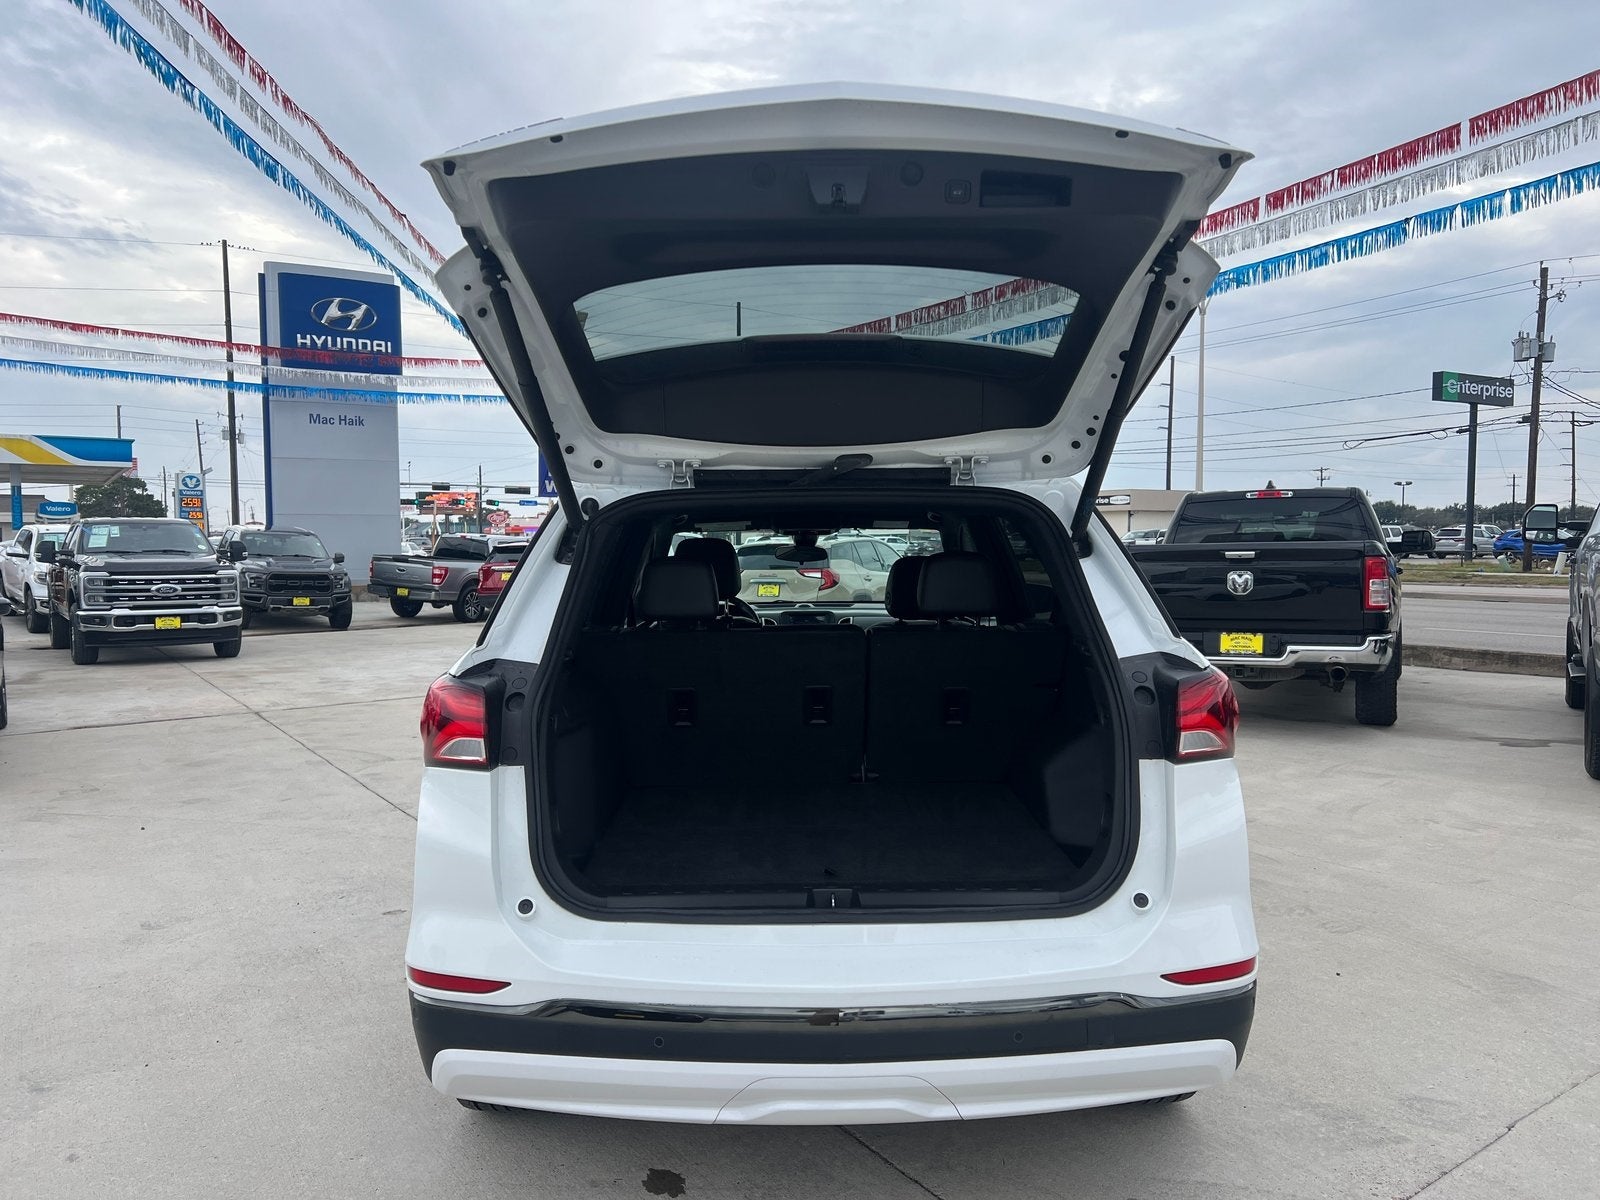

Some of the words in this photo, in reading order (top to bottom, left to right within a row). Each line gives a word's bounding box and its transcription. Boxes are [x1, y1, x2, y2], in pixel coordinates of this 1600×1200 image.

[296, 333, 392, 353] HYUNDAI
[1447, 379, 1514, 400] enterprise
[309, 413, 335, 425] Mac
[338, 414, 365, 427] Haik
